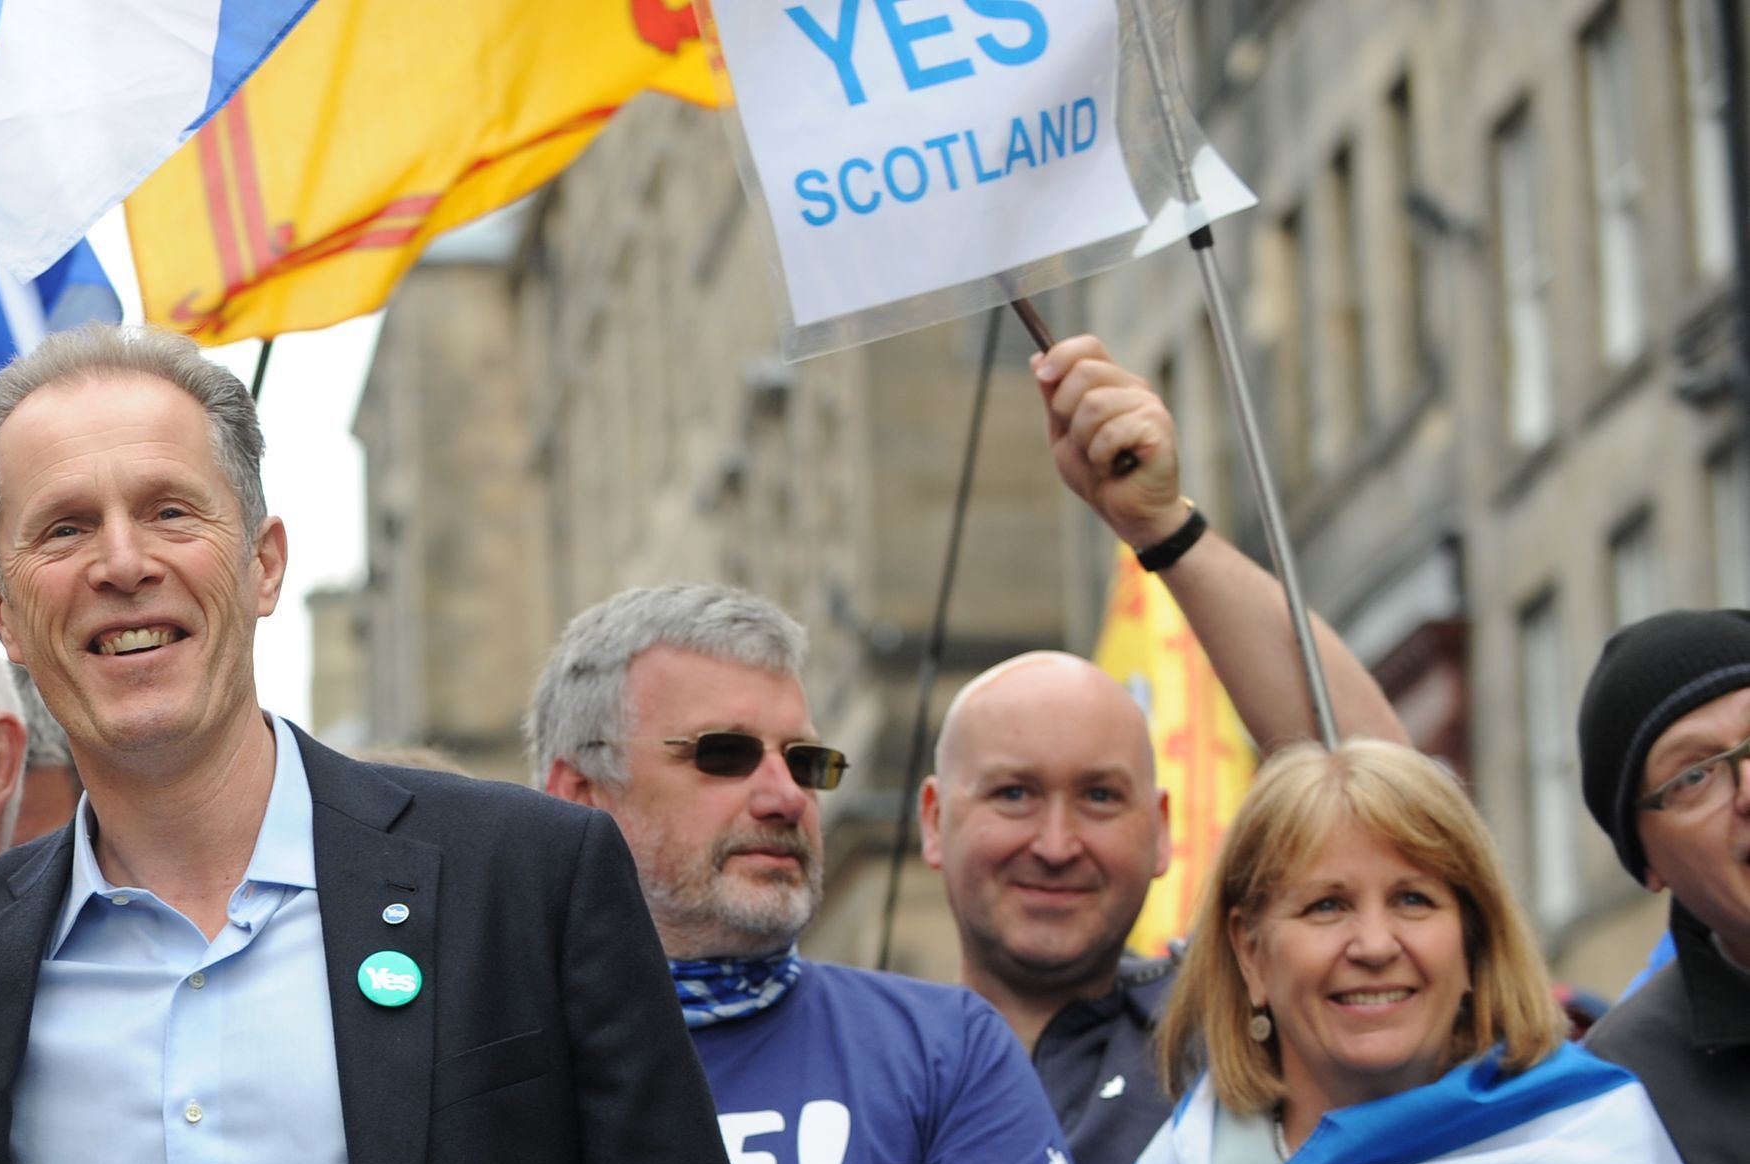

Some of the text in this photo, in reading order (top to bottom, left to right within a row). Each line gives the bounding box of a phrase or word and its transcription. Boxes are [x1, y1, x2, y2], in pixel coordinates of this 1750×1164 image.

[785, 0, 1050, 107] YES
[794, 96, 1098, 227] SCOTLAND
[365, 967, 416, 992] Yes
